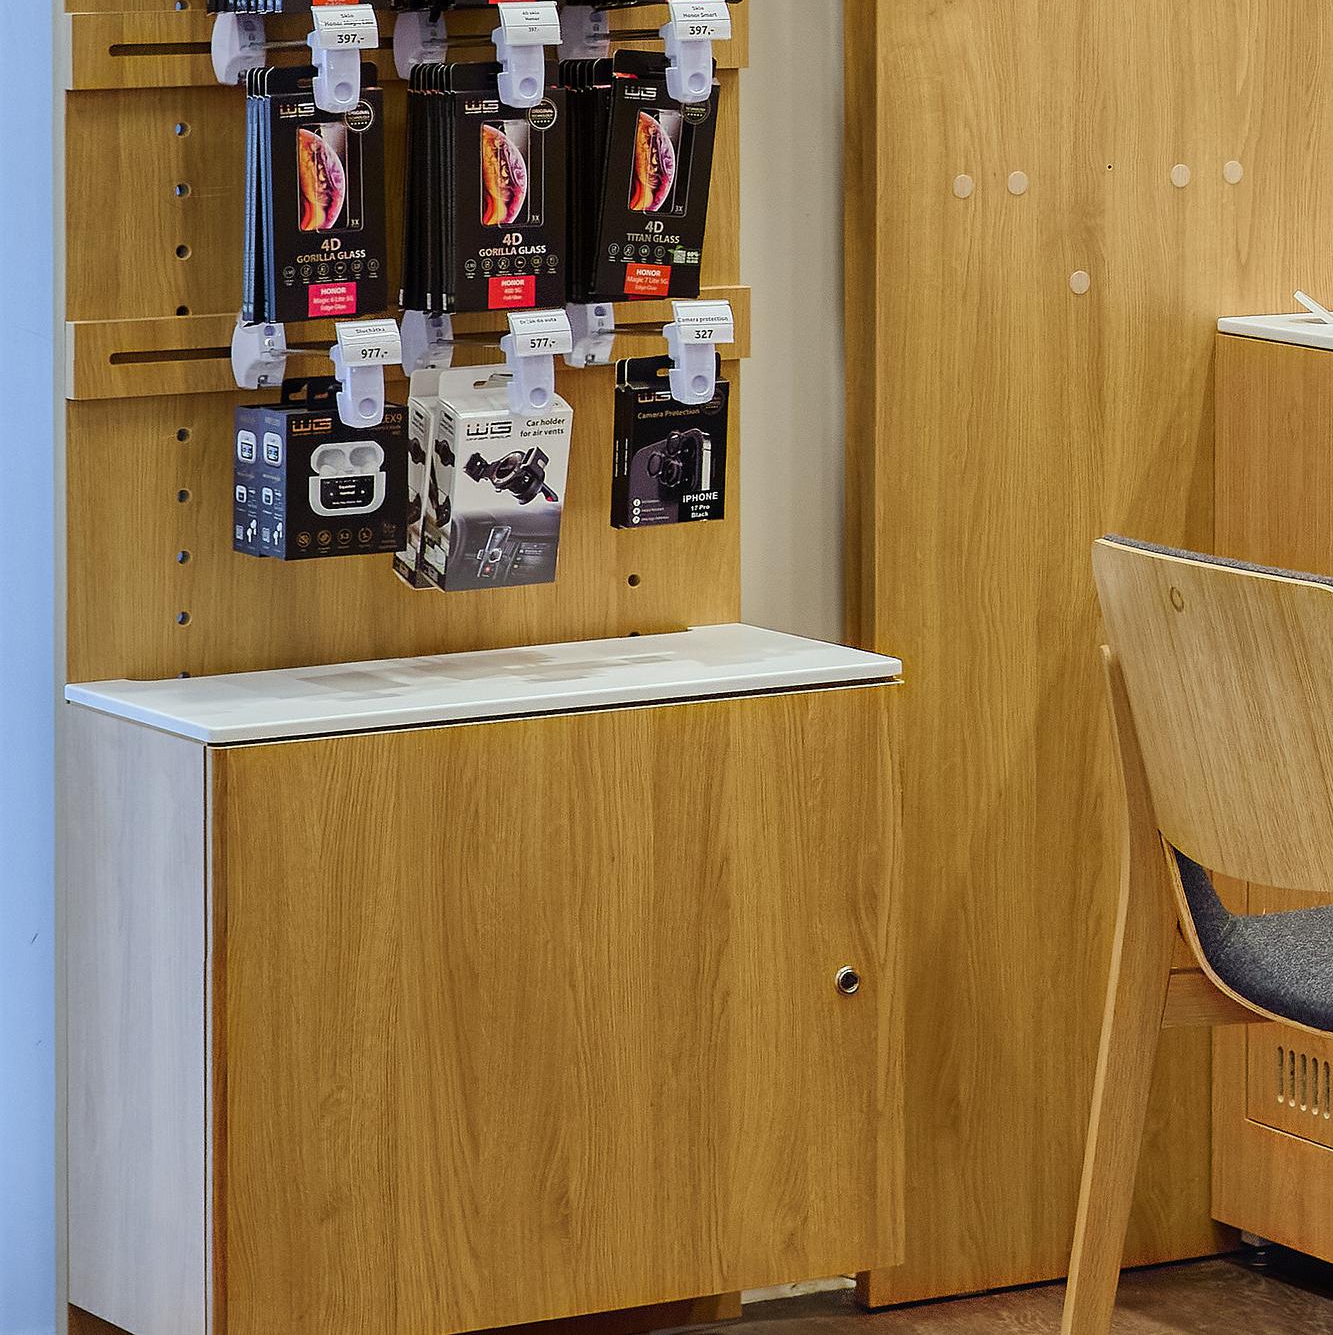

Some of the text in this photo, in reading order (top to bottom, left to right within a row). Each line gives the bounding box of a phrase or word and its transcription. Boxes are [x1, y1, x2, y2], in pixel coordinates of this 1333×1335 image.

[644, 220, 665, 233] 4D
[502, 232, 523, 246] 4D
[626, 232, 680, 244] TITAN GLASS
[320, 237, 342, 252] 4D
[478, 244, 547, 257] GORILLA GLASS
[296, 249, 366, 263] GORILLA GLASS
[636, 268, 661, 277] HONOR
[501, 279, 525, 287] HONOR
[320, 286, 347, 295] HONOR
[694, 329, 714, 339] 327
[637, 408, 700, 420] Camera Protection
[526, 418, 565, 427] Car holder
